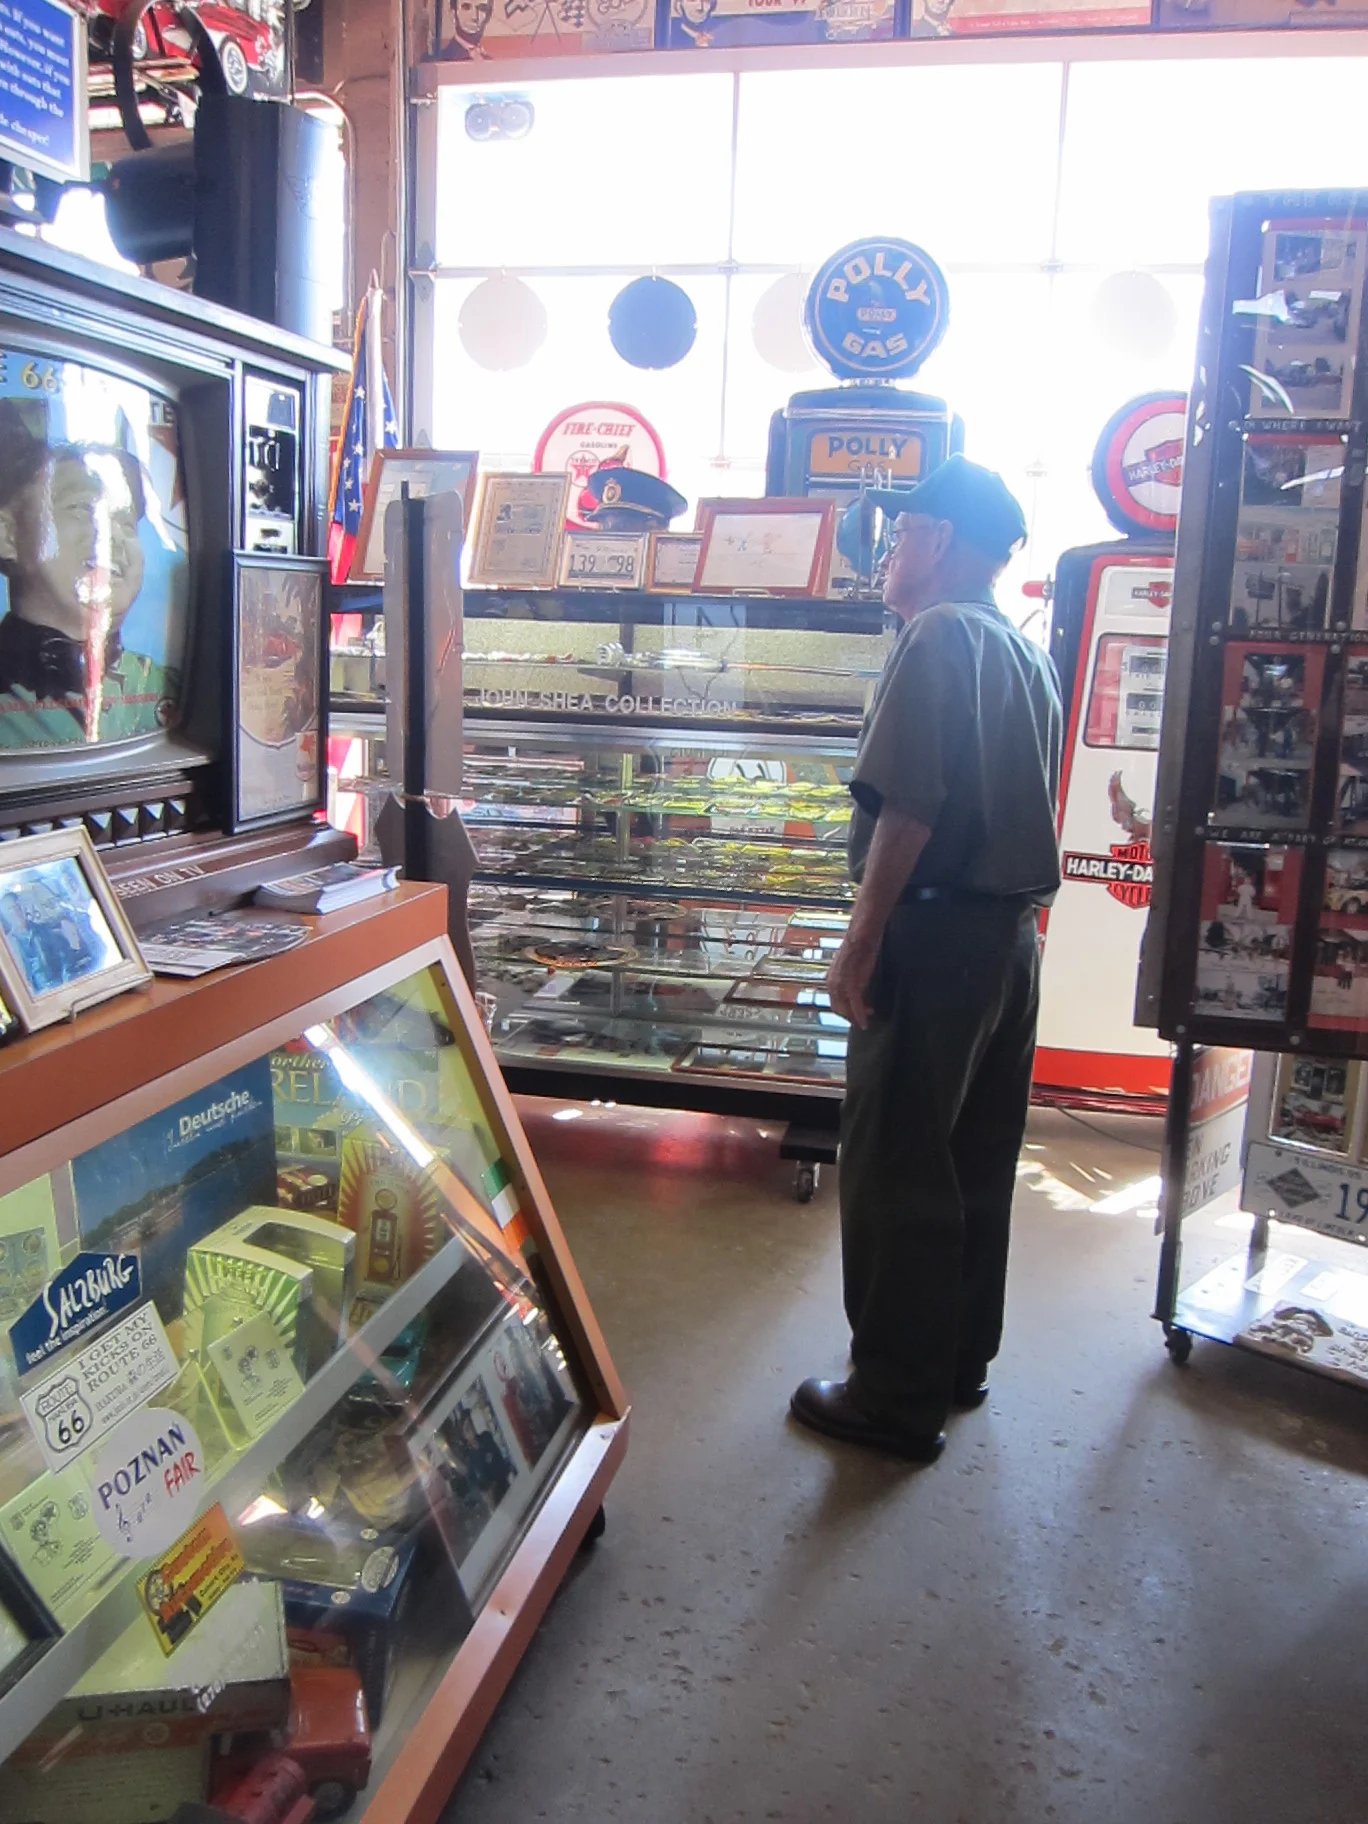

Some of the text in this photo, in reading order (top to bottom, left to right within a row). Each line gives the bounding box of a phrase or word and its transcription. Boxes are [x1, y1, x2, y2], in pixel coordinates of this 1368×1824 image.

[49, 103, 64, 119] the
[827, 252, 930, 305] POLLY
[842, 332, 908, 358] GAS
[563, 421, 636, 437] FIRE-CHIEF
[828, 436, 908, 459] POLLY
[475, 689, 737, 716] JOHN SHEA COLLECTION
[117, 865, 206, 899] SEEN ON TV
[179, 1090, 250, 1137] Deutsche
[43, 1253, 134, 1340] SALZBURG
[81, 1325, 153, 1381] KICKS ON
[89, 1332, 121, 1361] GET
[125, 1312, 148, 1336] MY
[86, 1335, 158, 1393] ROUTE 66
[58, 1408, 85, 1445] 66
[98, 1420, 185, 1510] POZNAN
[163, 1451, 201, 1498] FAIR
